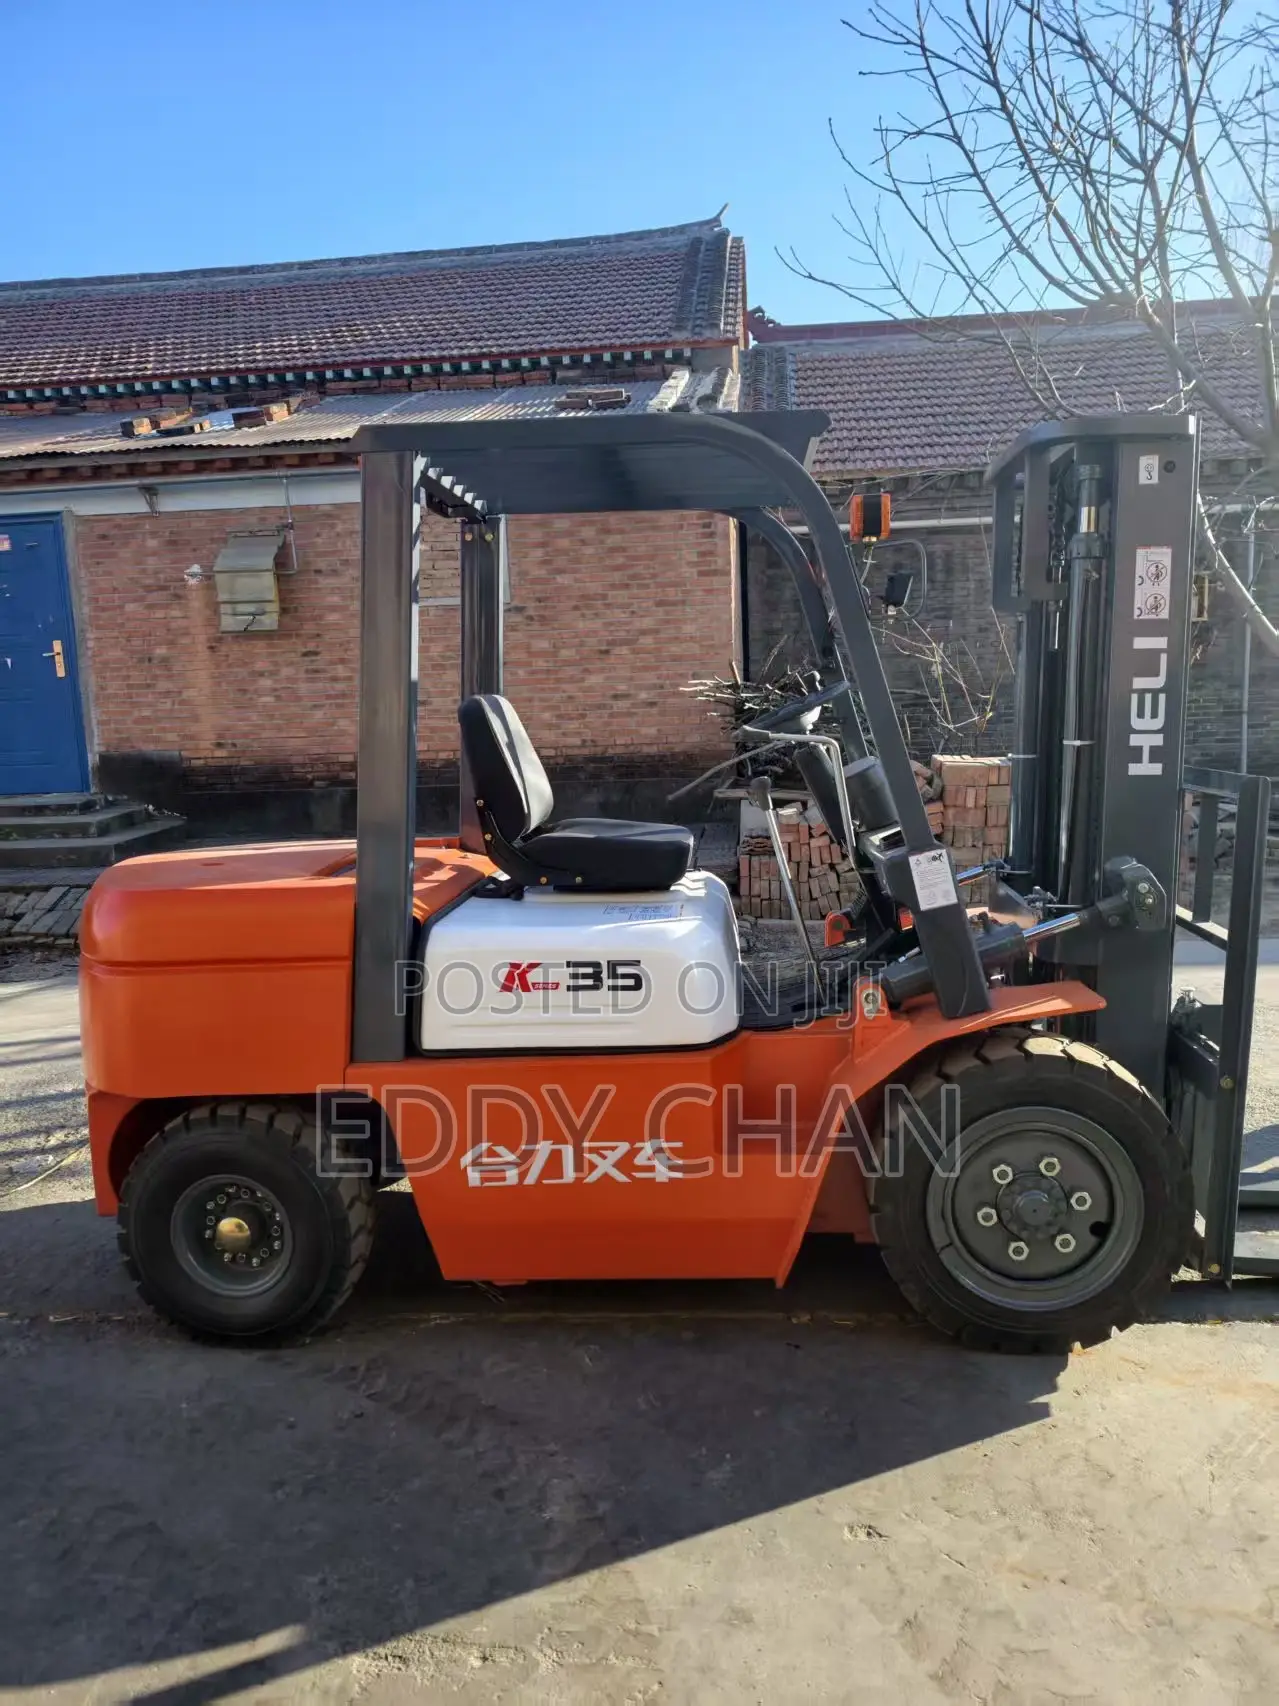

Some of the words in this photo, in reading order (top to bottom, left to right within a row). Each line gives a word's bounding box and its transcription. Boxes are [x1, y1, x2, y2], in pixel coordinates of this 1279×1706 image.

[1128, 637, 1168, 776] HELI
[499, 962, 543, 992] K
[566, 960, 643, 991] 35
[460, 1139, 683, 1187] 合力叉车
